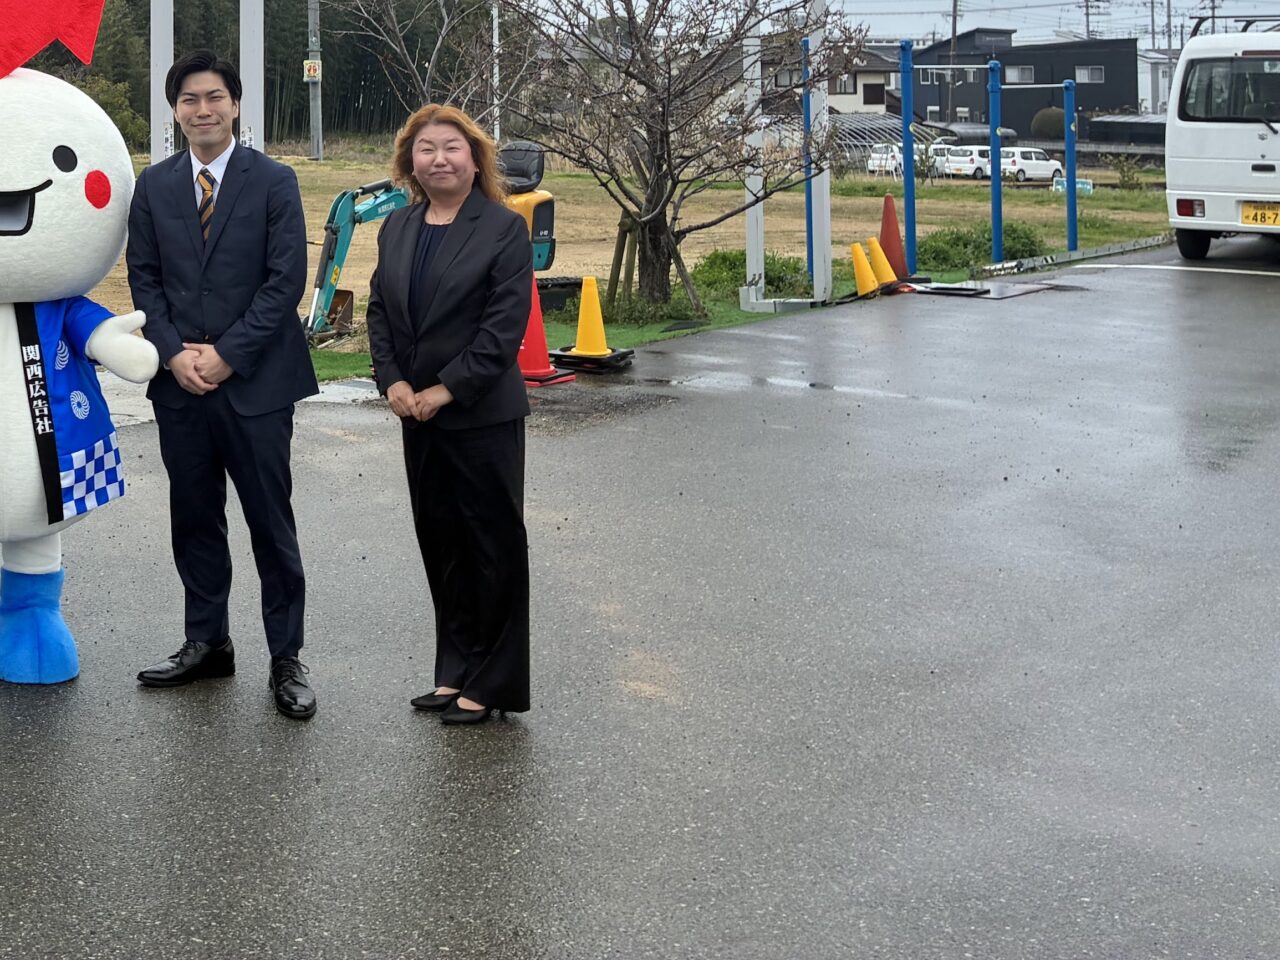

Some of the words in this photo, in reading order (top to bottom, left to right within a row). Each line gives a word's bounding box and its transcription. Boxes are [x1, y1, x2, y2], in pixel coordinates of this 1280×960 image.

[22, 344, 54, 435] 関西広告社
